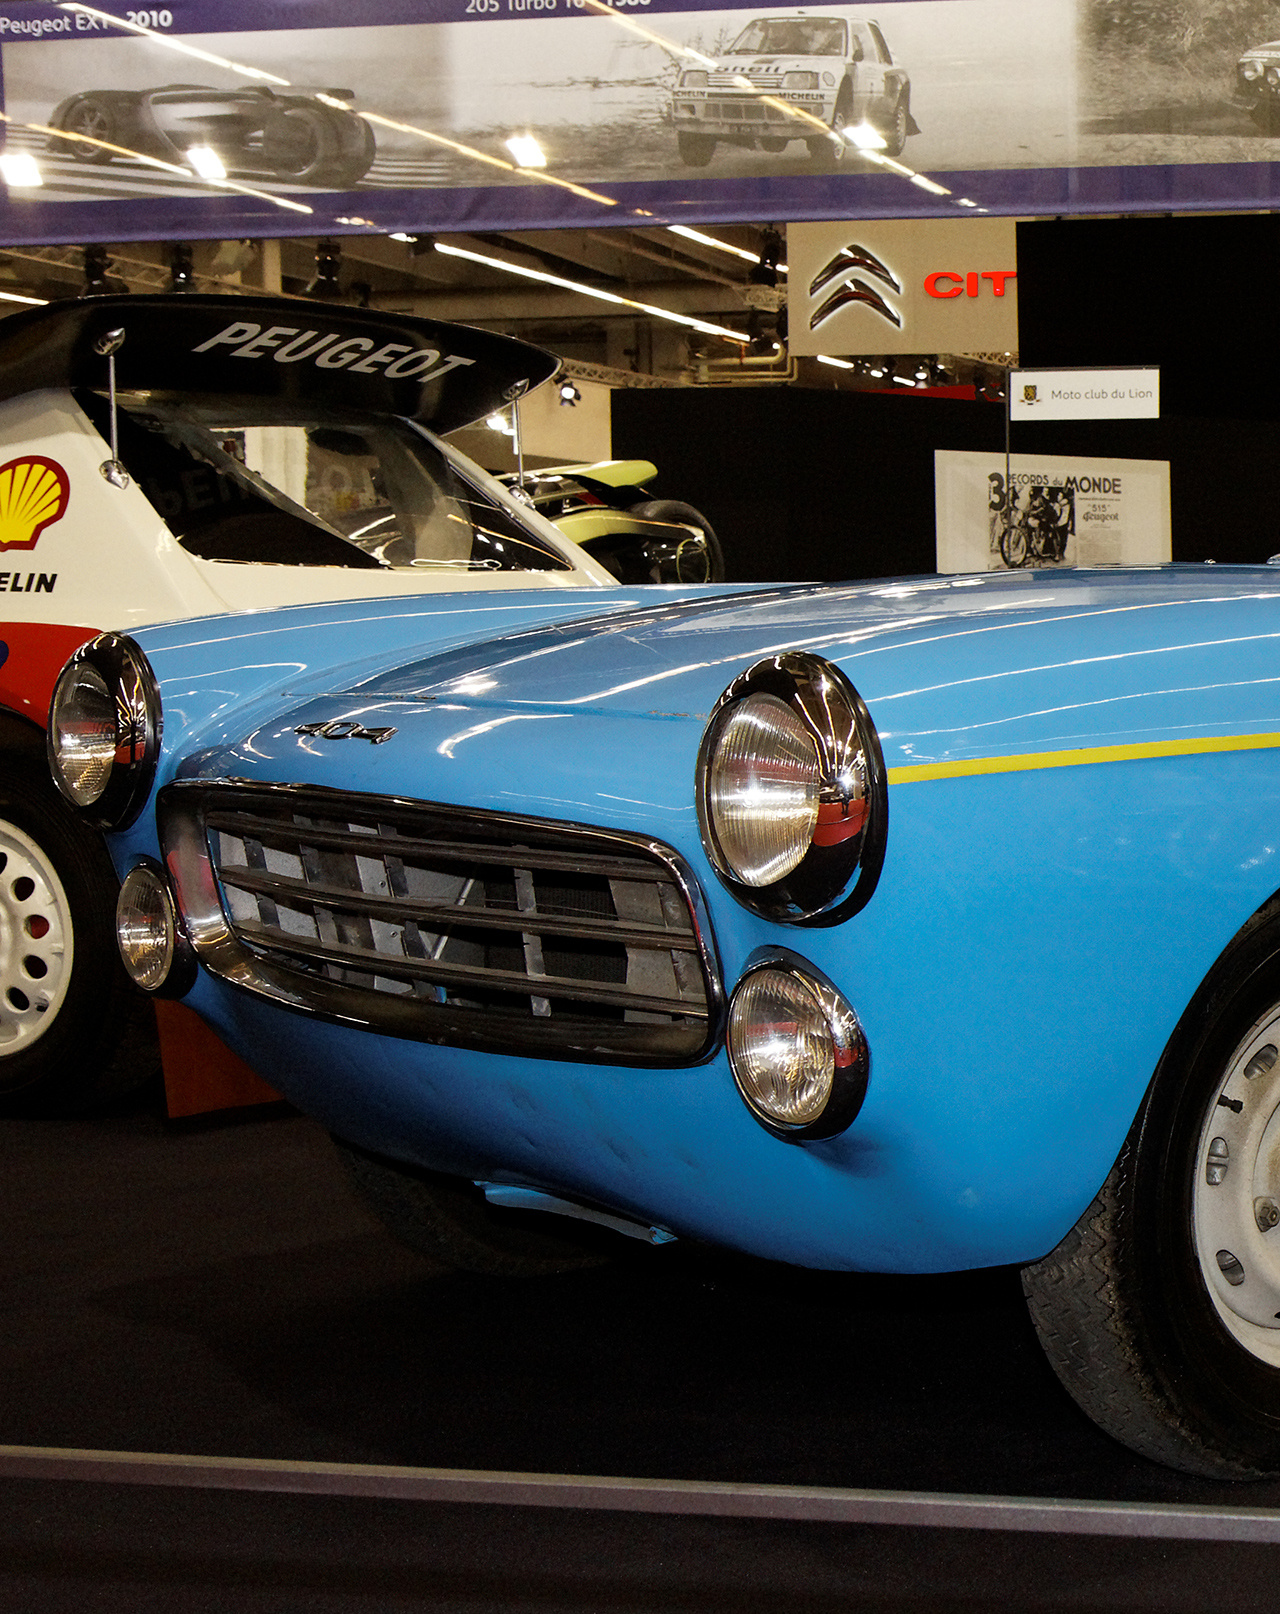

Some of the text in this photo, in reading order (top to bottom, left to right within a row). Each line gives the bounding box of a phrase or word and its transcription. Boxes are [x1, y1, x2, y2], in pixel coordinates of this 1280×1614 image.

[0, 16, 71, 37] Peugeot
[126, 10, 173, 28] 2010
[778, 92, 825, 100] MICHELIN
[924, 271, 1017, 298] CIT
[191, 321, 477, 383] PEUGEOT
[1051, 388, 1153, 400] Moto club du Lion
[988, 472, 1005, 511] 3
[1064, 476, 1122, 494] MONDE
[294, 721, 399, 745] 404
